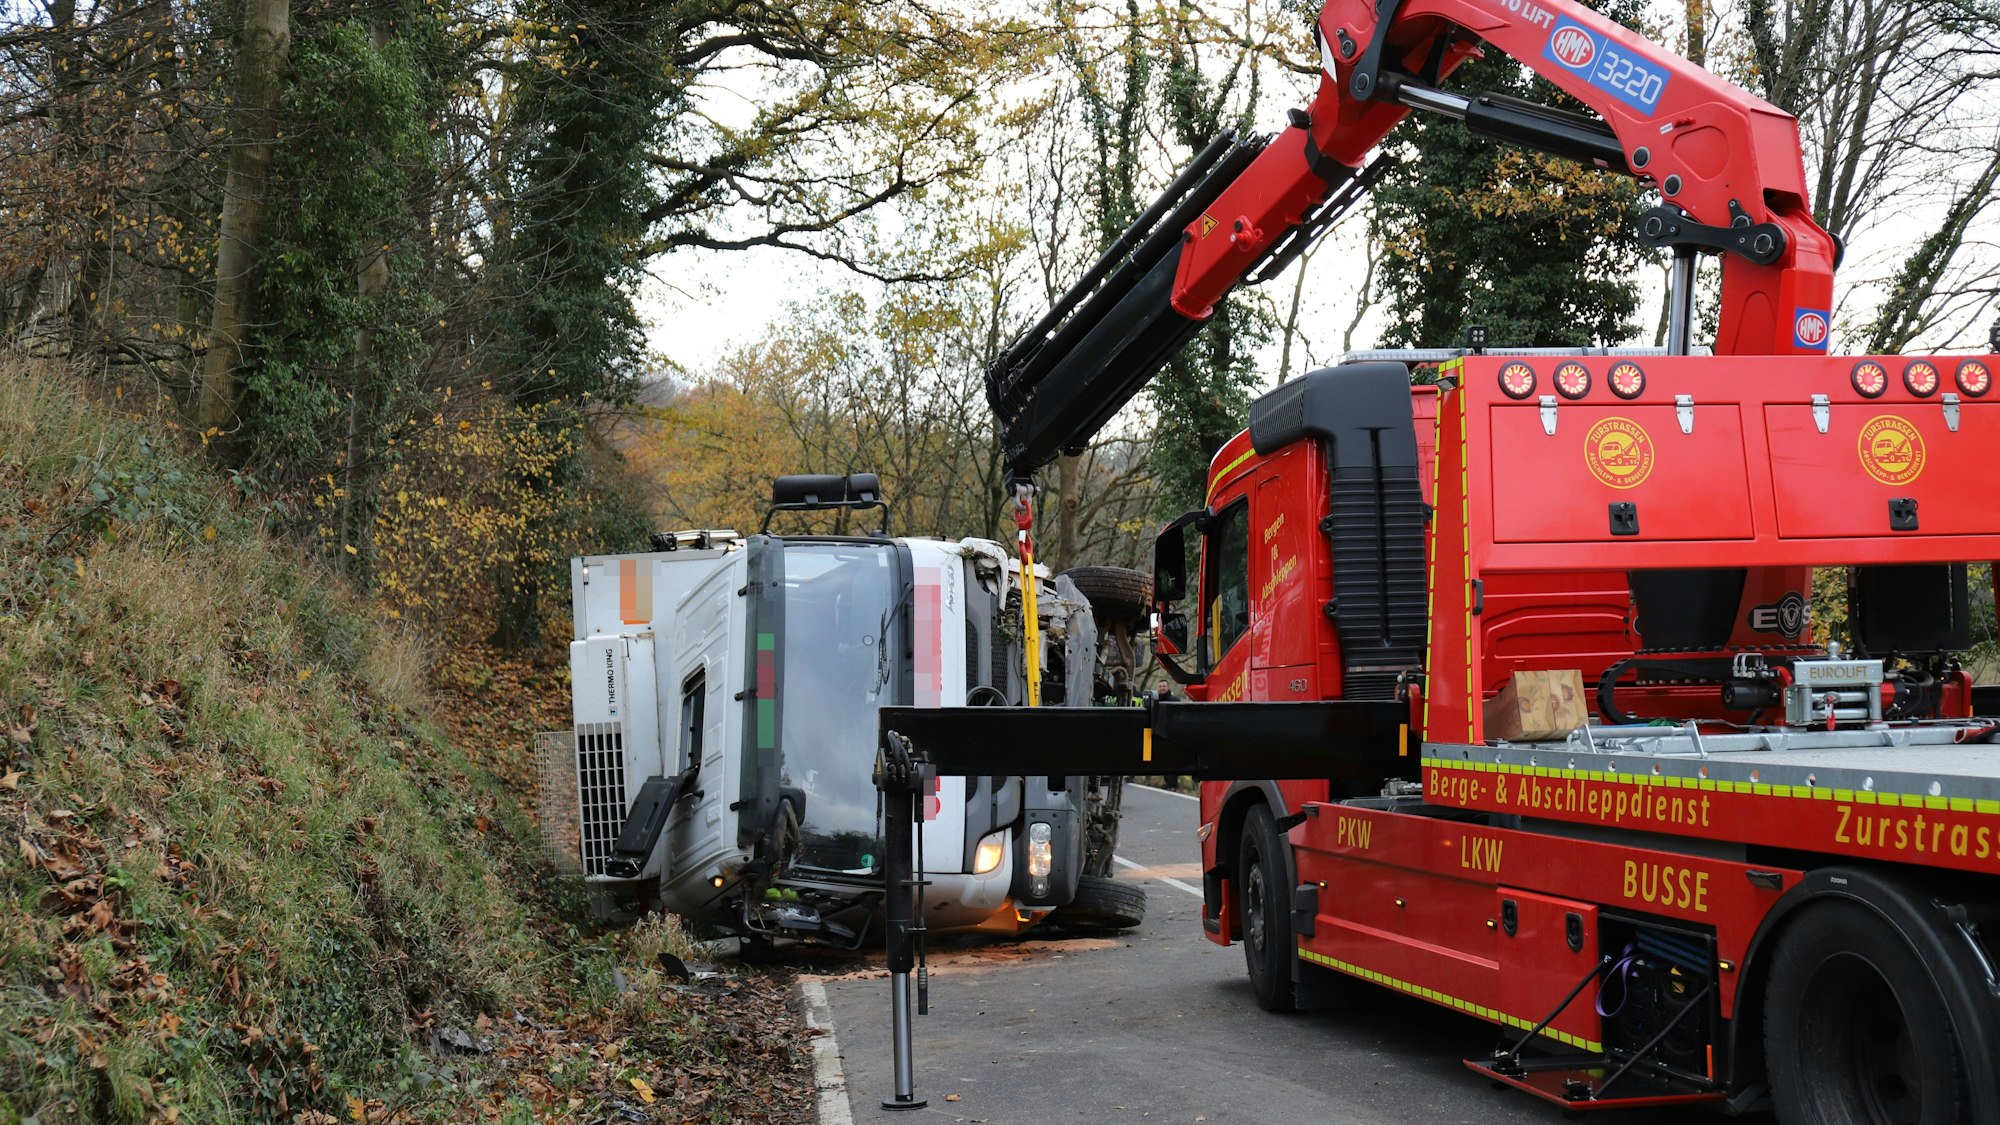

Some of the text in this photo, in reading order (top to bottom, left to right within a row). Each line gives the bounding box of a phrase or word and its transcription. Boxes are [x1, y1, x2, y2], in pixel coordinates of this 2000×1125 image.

[1521, 2, 1555, 30] LIFT
[1555, 31, 1590, 64] HMF
[1597, 51, 1663, 105] 3220
[1800, 316, 1824, 341] HMF
[1590, 421, 1646, 444] ZURSTRASSEN
[1863, 419, 1917, 441] ZURSTRASSEN
[1264, 512, 1284, 545] Bergen
[1262, 554, 1297, 602] Abschleppen
[605, 648, 613, 668] KING
[1810, 666, 1869, 679] EUROLIFT
[607, 669, 616, 704] THERMO
[1289, 679, 1308, 691] 460
[1430, 769, 1711, 828] Berge- & Abschleppdienst
[1338, 816, 1372, 850] PKW
[1835, 805, 2000, 861] Zurstras
[1461, 835, 1503, 873] LKW
[1623, 859, 1710, 913] BUSSE
